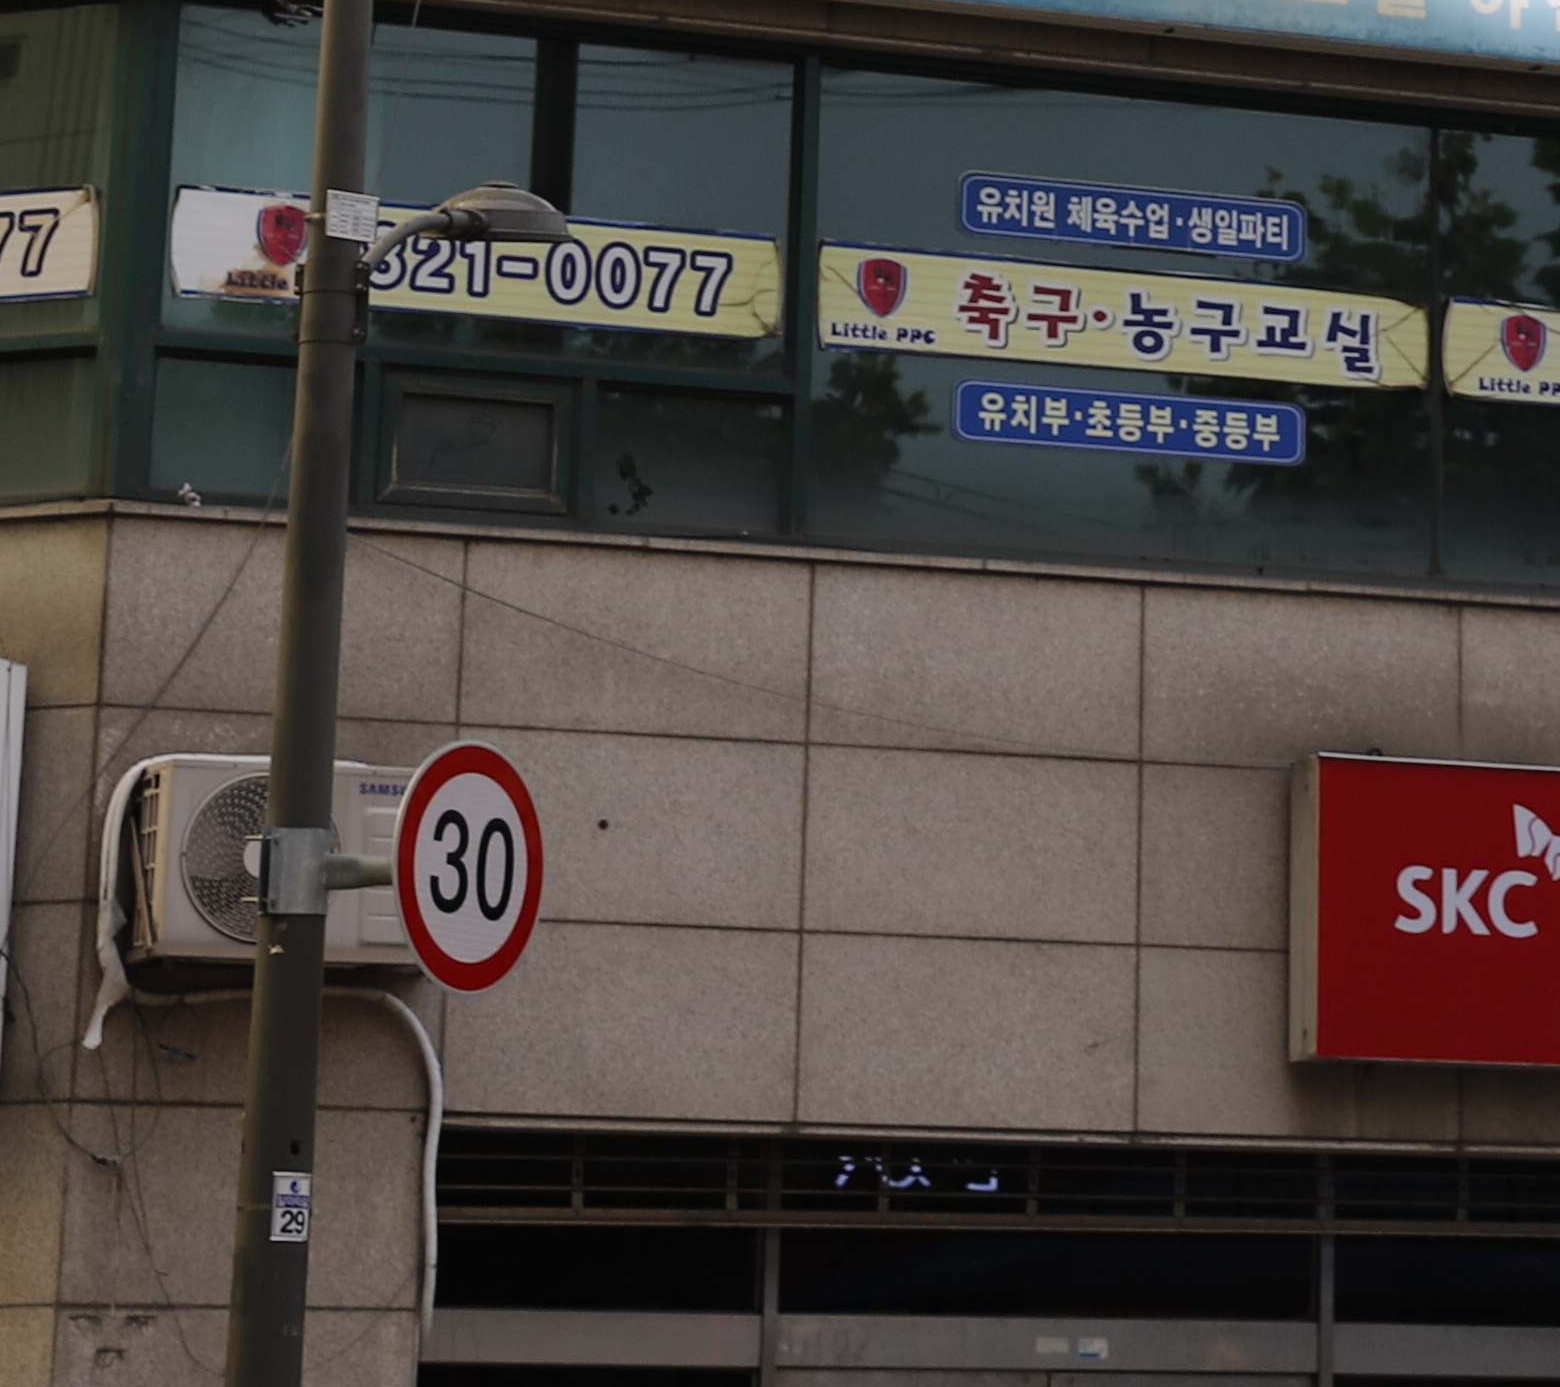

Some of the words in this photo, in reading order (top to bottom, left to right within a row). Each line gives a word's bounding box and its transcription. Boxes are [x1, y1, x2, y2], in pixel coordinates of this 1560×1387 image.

[975, 185, 1056, 231] 유치원
[830, 321, 888, 344] Little
[1478, 375, 1531, 396] Little
[359, 782, 406, 797] SAMS
[429, 808, 516, 922] 30
[1394, 865, 1538, 940] SKC
[280, 1210, 306, 1234] 29
